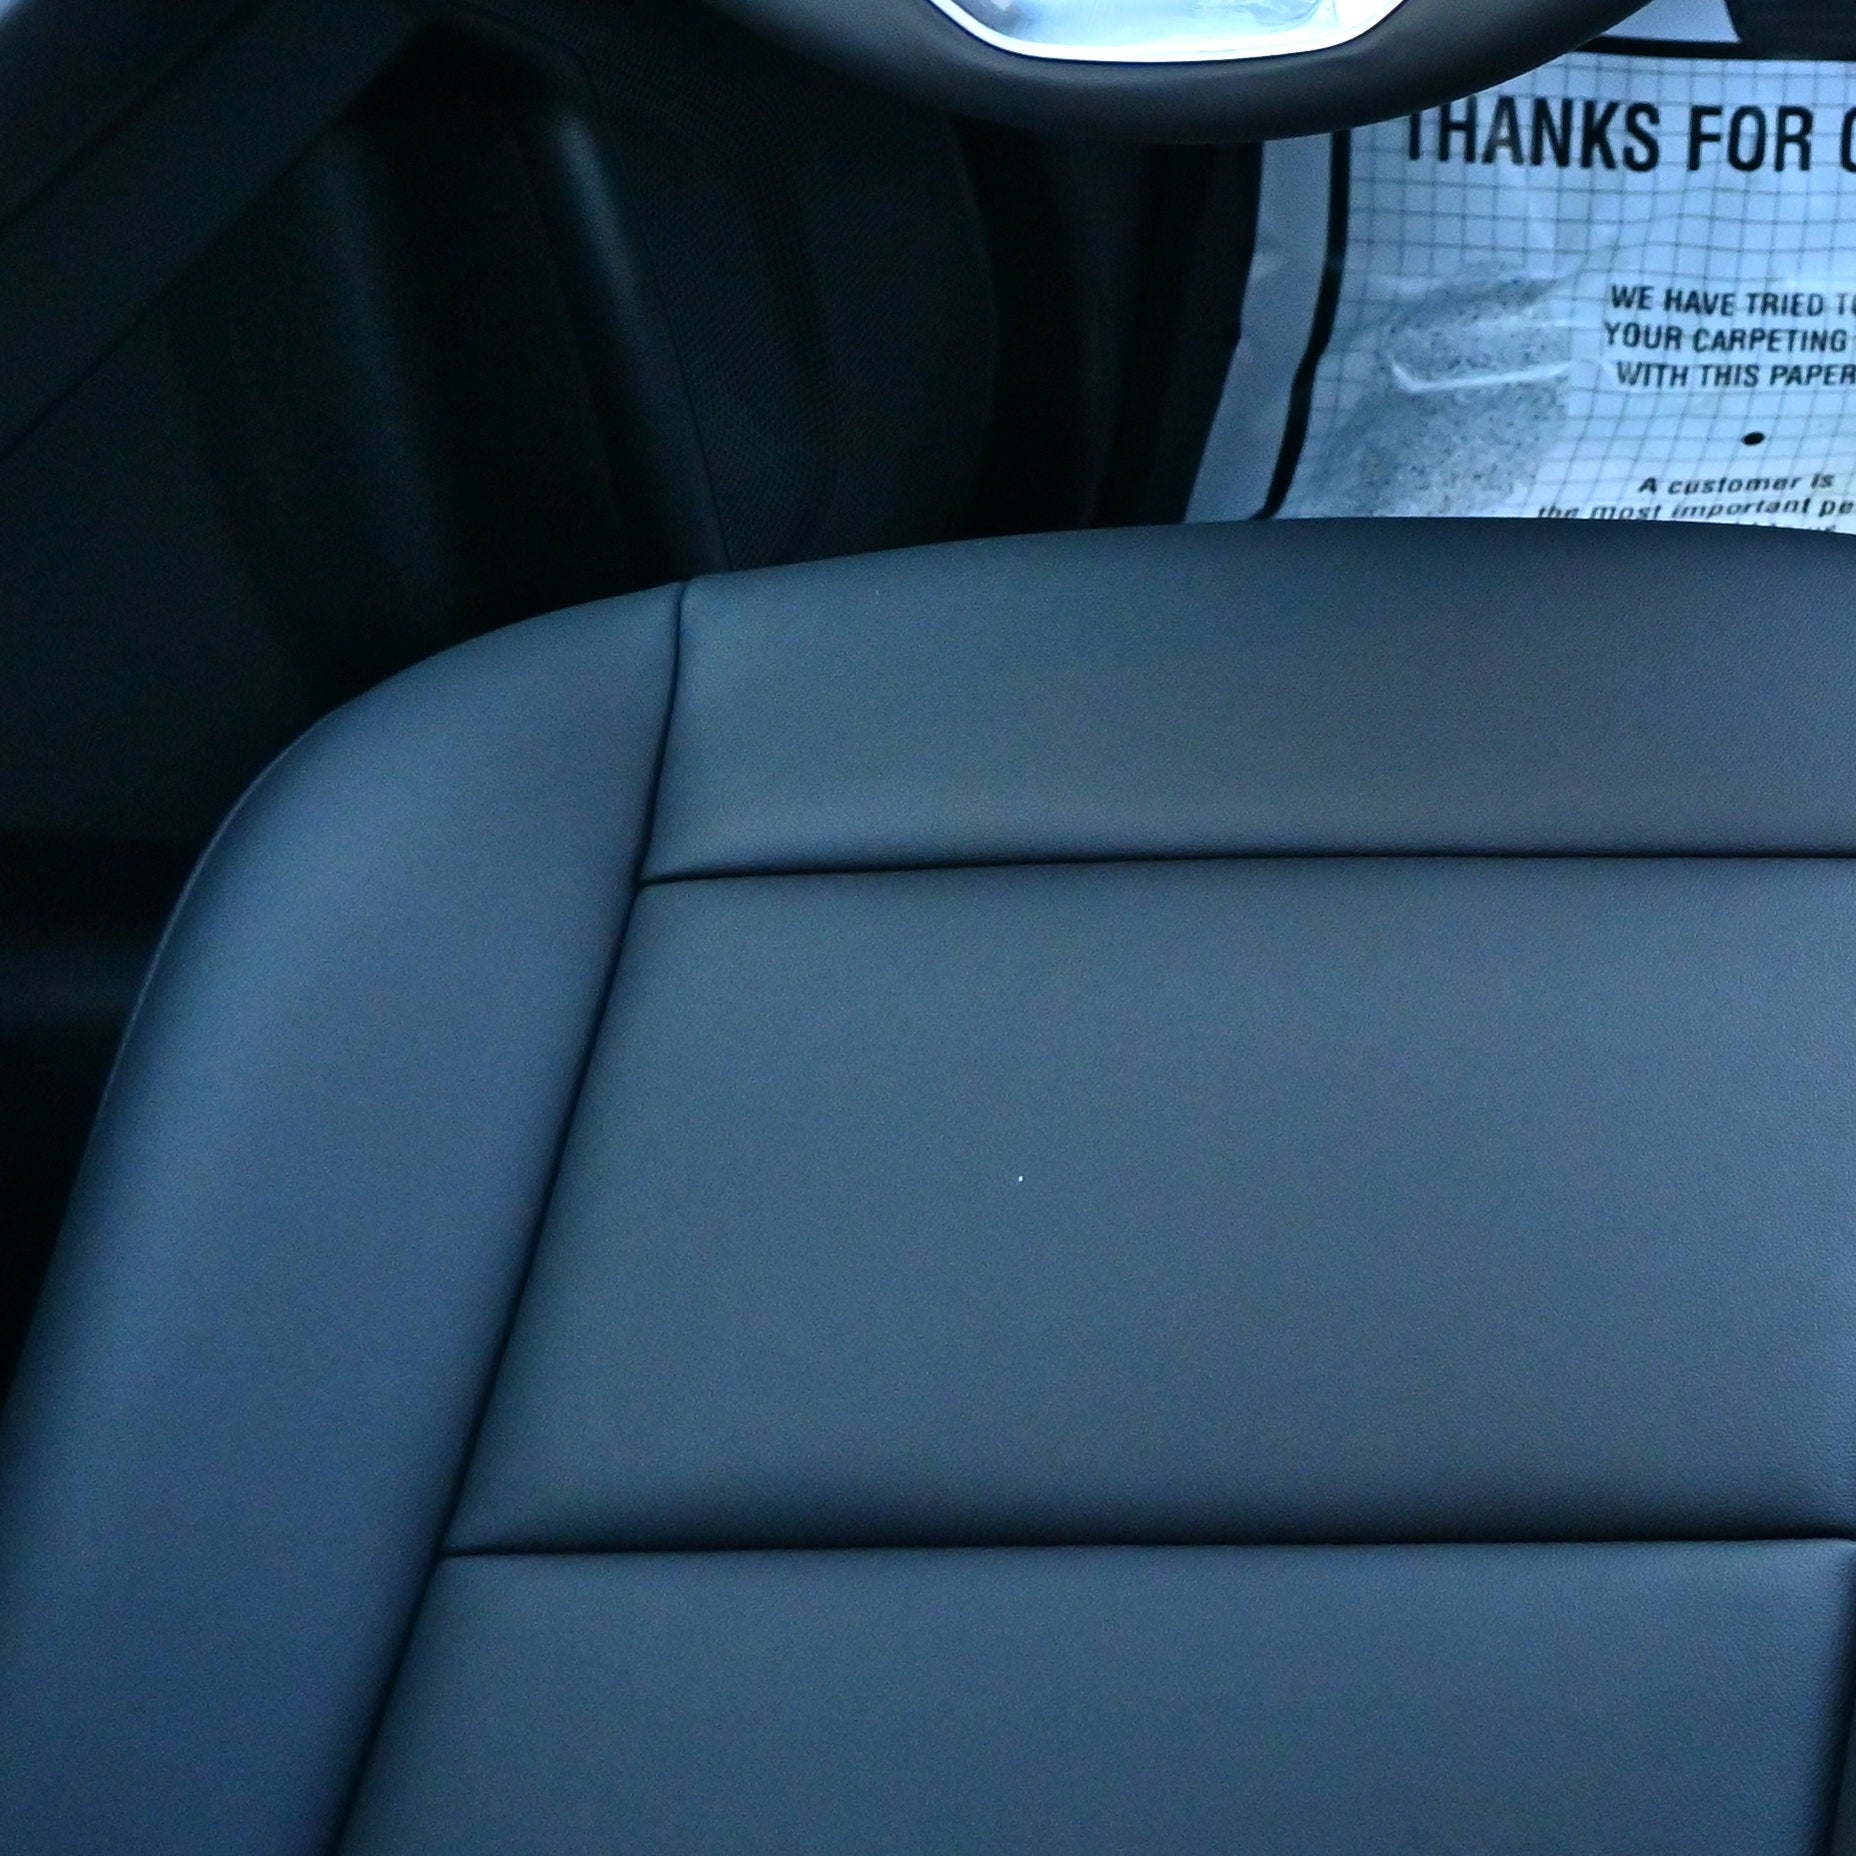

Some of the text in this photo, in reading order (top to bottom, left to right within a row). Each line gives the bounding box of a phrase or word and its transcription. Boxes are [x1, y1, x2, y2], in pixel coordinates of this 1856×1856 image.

[1687, 105, 1815, 173] FOR
[1609, 284, 1655, 311] WE
[1663, 287, 1736, 317] HAVE
[1746, 291, 1824, 317] TRIED
[1604, 320, 1684, 352] YOUR
[1692, 327, 1848, 353] CARPETING
[1616, 360, 1689, 388] WITH
[1700, 362, 1760, 388] THIS
[1769, 362, 1856, 386] PAPER
[1638, 472, 1837, 495] A customer is
[1538, 502, 1580, 520] the
[1590, 503, 1662, 521] most
[1672, 496, 1811, 520] important
